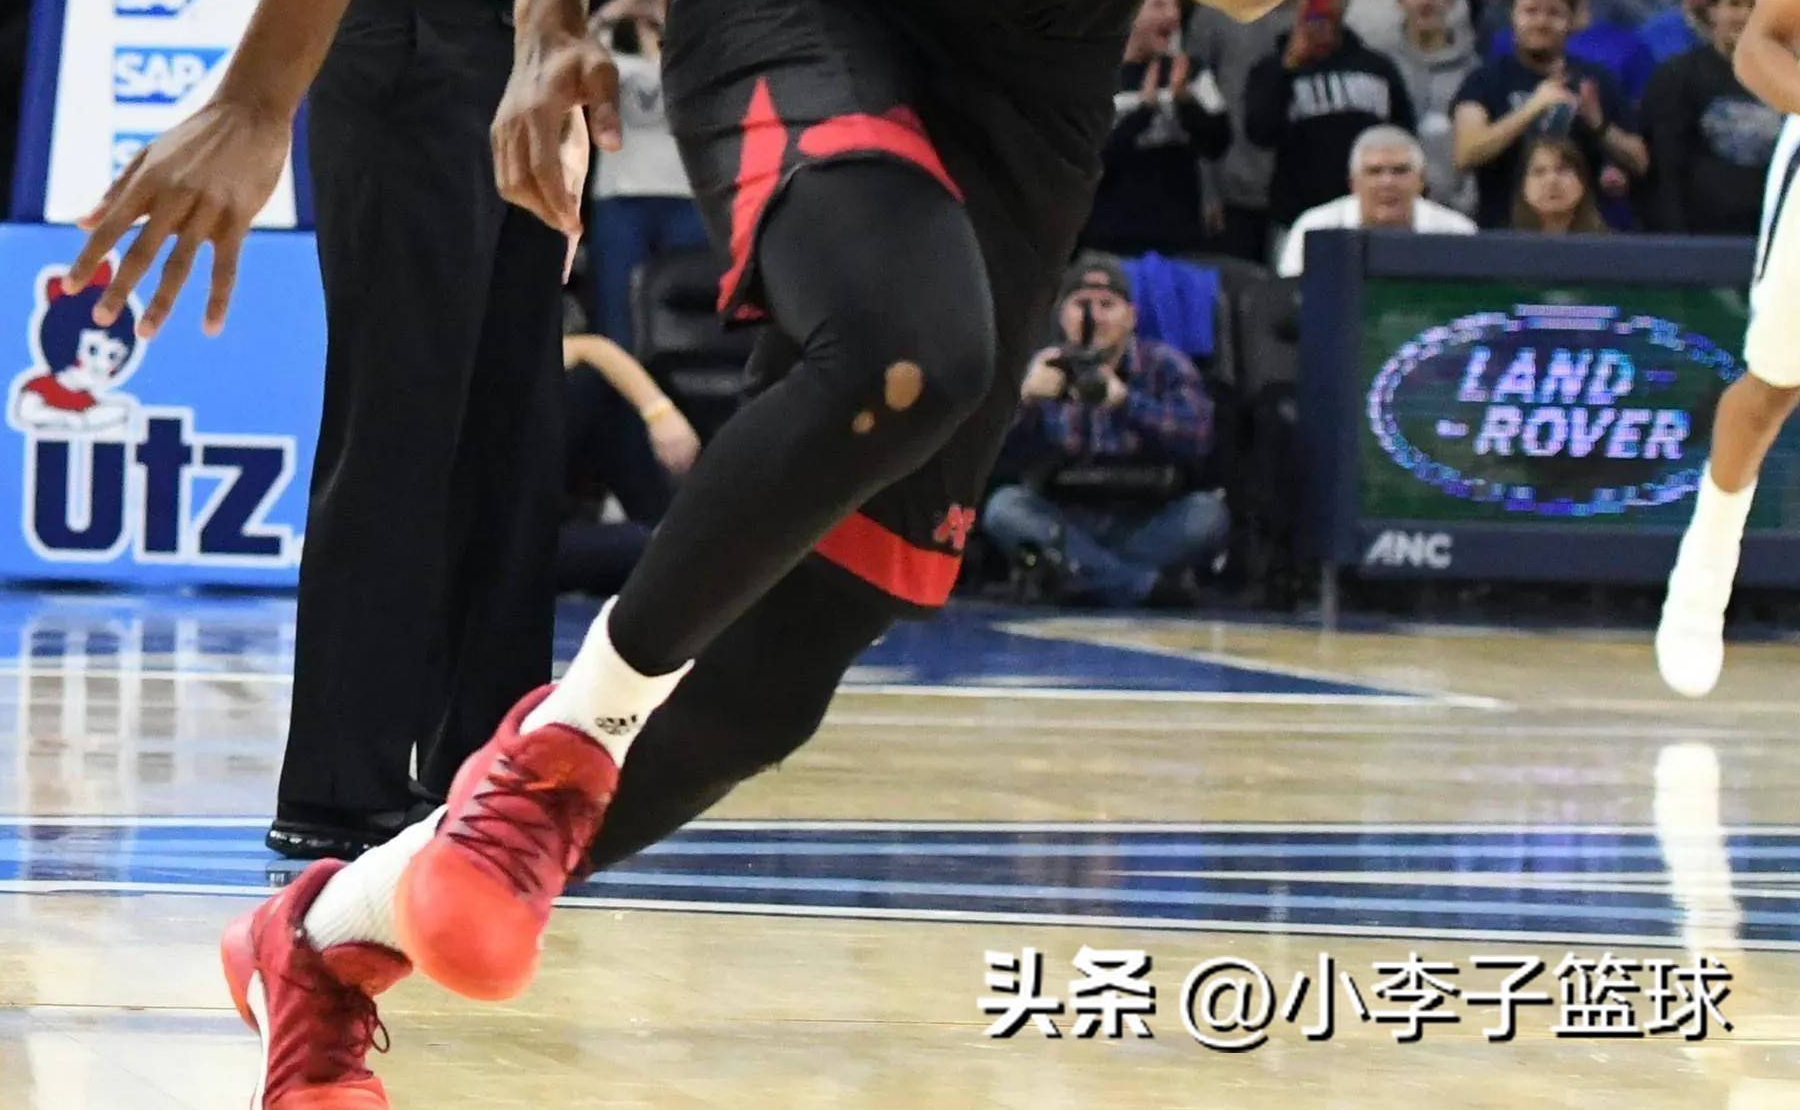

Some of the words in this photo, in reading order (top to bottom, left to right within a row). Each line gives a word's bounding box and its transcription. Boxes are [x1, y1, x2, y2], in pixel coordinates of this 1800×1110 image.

[115, 52, 205, 97] SAP
[1457, 345, 1637, 405] LAND
[1473, 407, 1691, 461] ROVER
[1364, 531, 1454, 569] ANC
